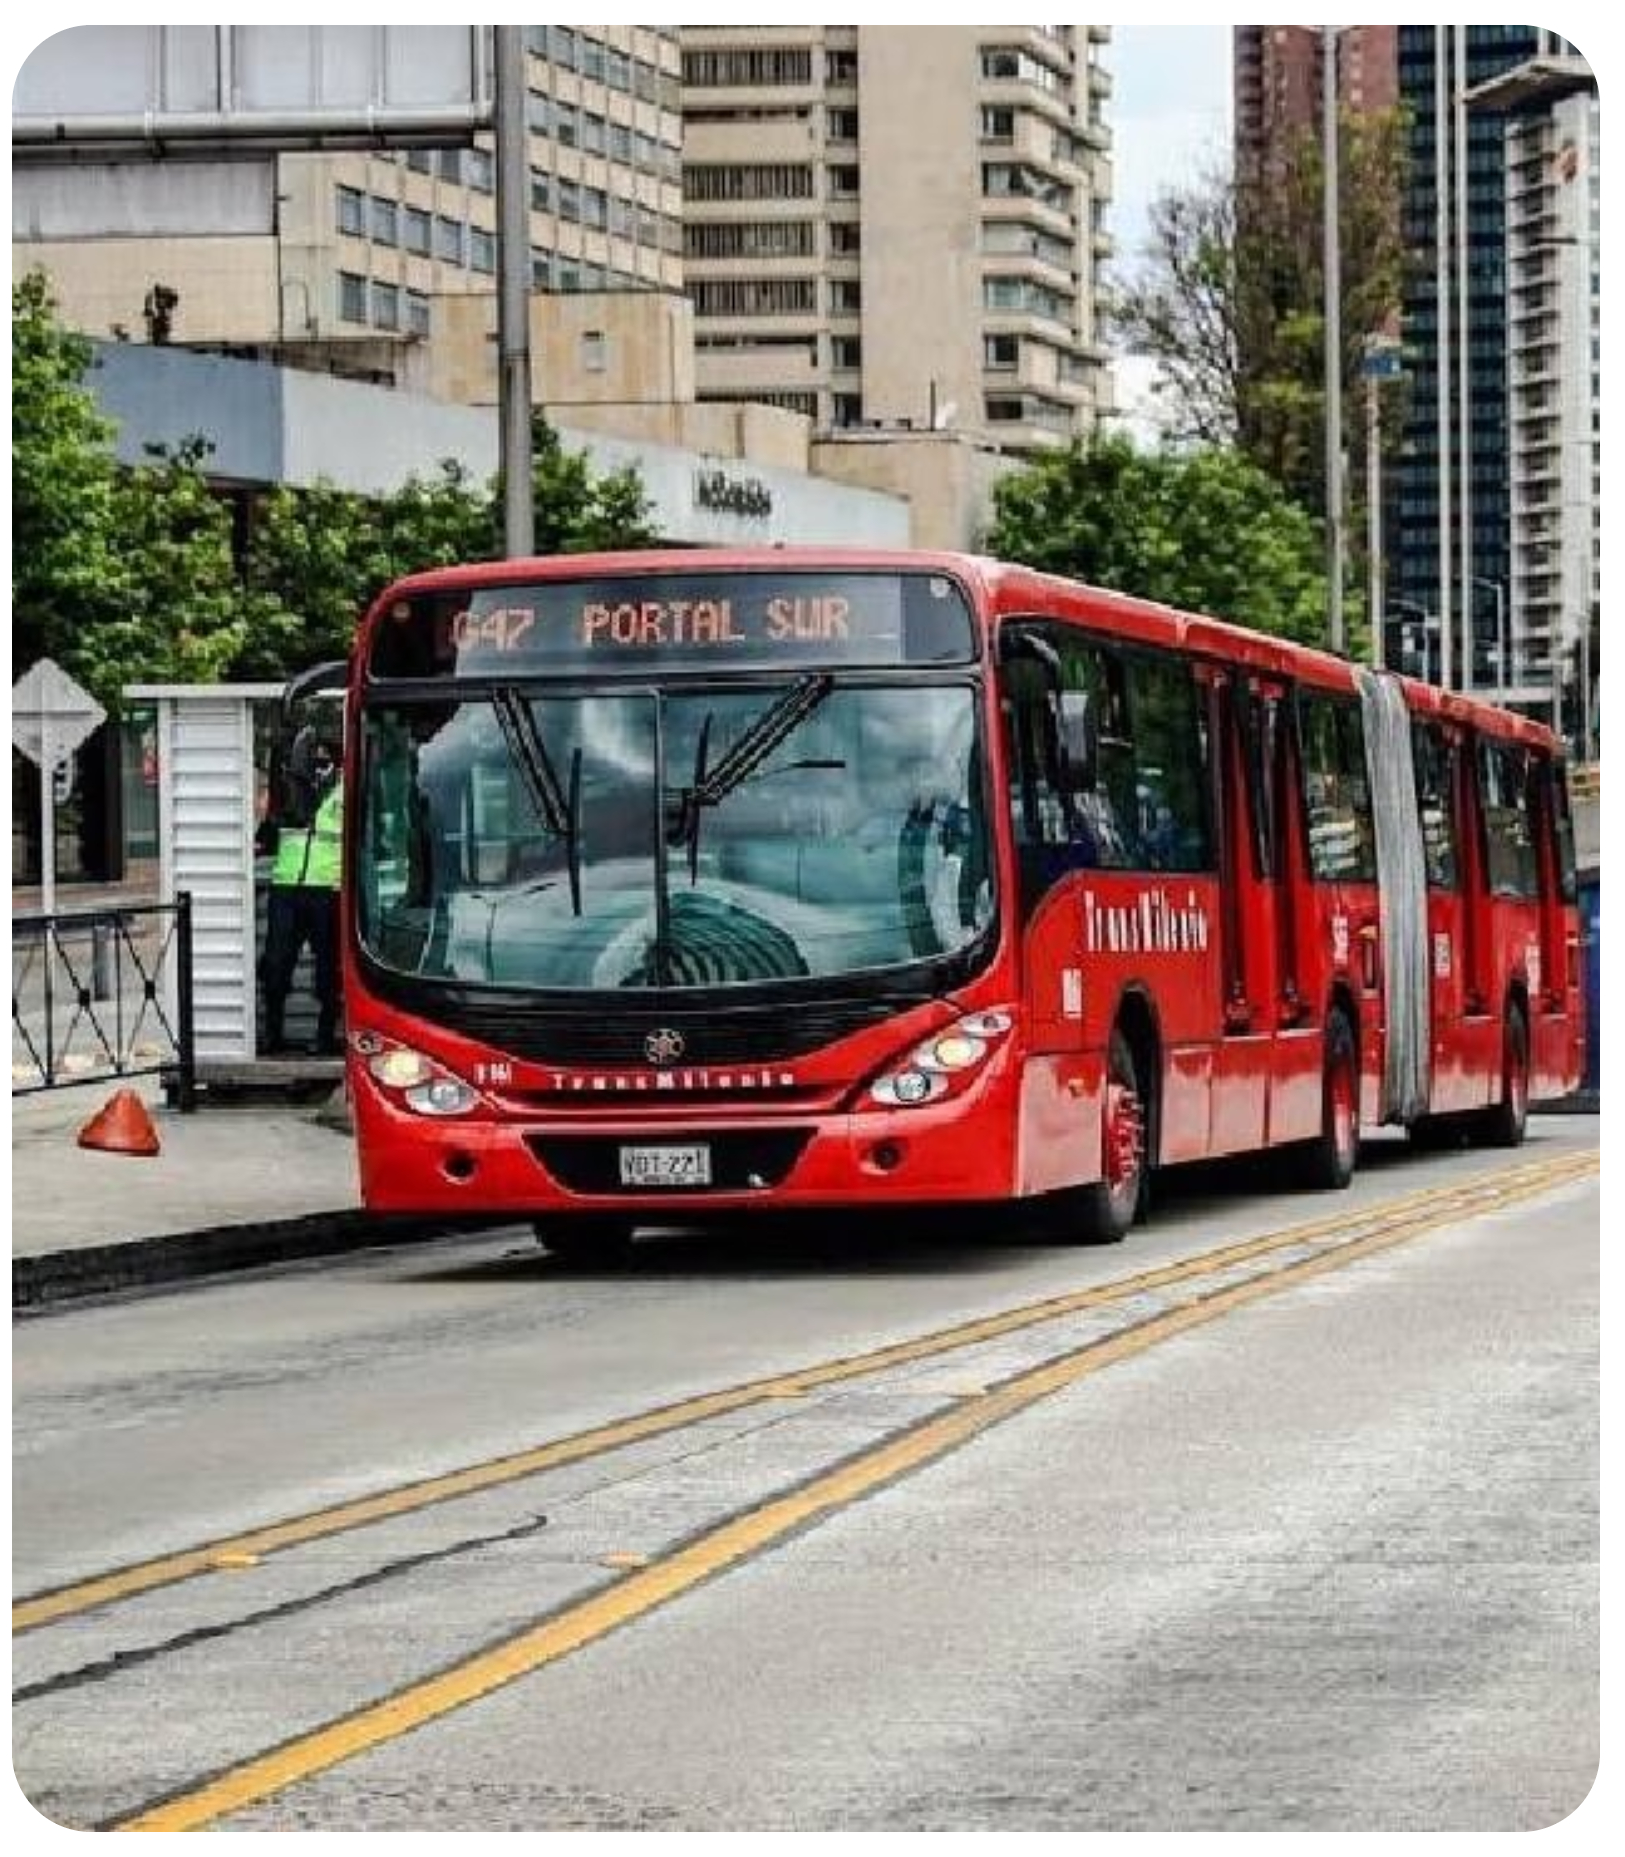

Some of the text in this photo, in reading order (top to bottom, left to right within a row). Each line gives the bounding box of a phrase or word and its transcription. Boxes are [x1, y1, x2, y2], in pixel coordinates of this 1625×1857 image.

[451, 593, 850, 652] G47 PORTAL SUR
